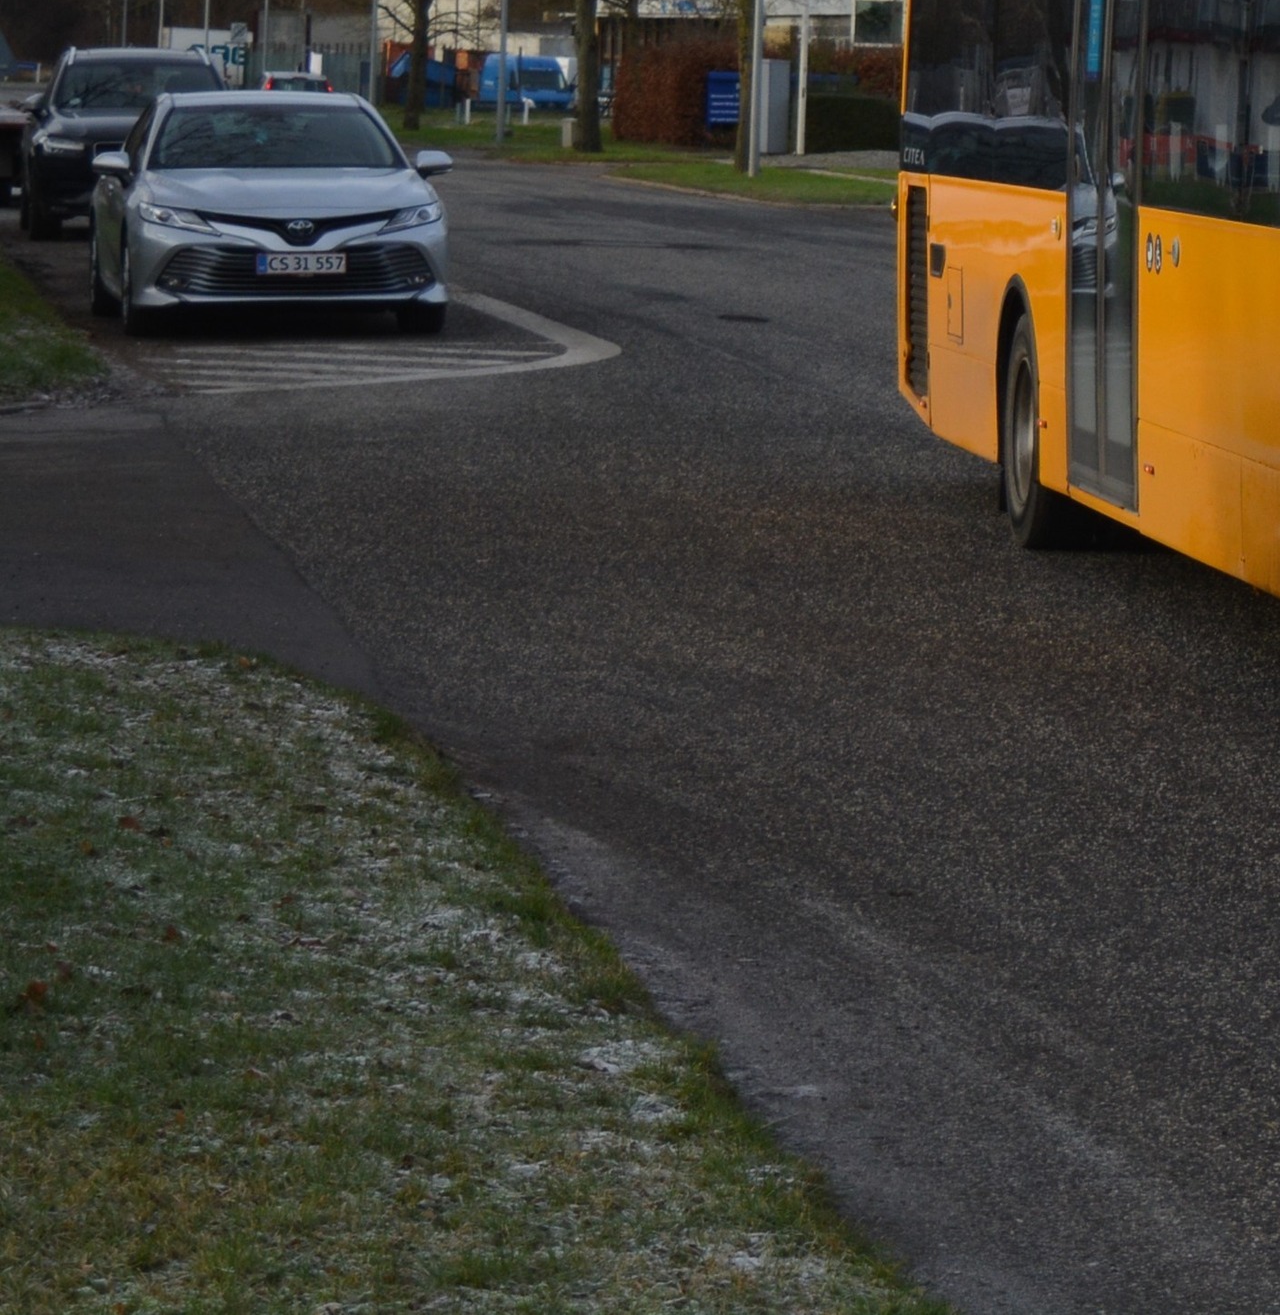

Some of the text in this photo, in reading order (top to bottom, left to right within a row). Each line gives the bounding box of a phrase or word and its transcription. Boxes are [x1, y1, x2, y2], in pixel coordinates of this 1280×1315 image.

[268, 256, 344, 271] CS 31 557
